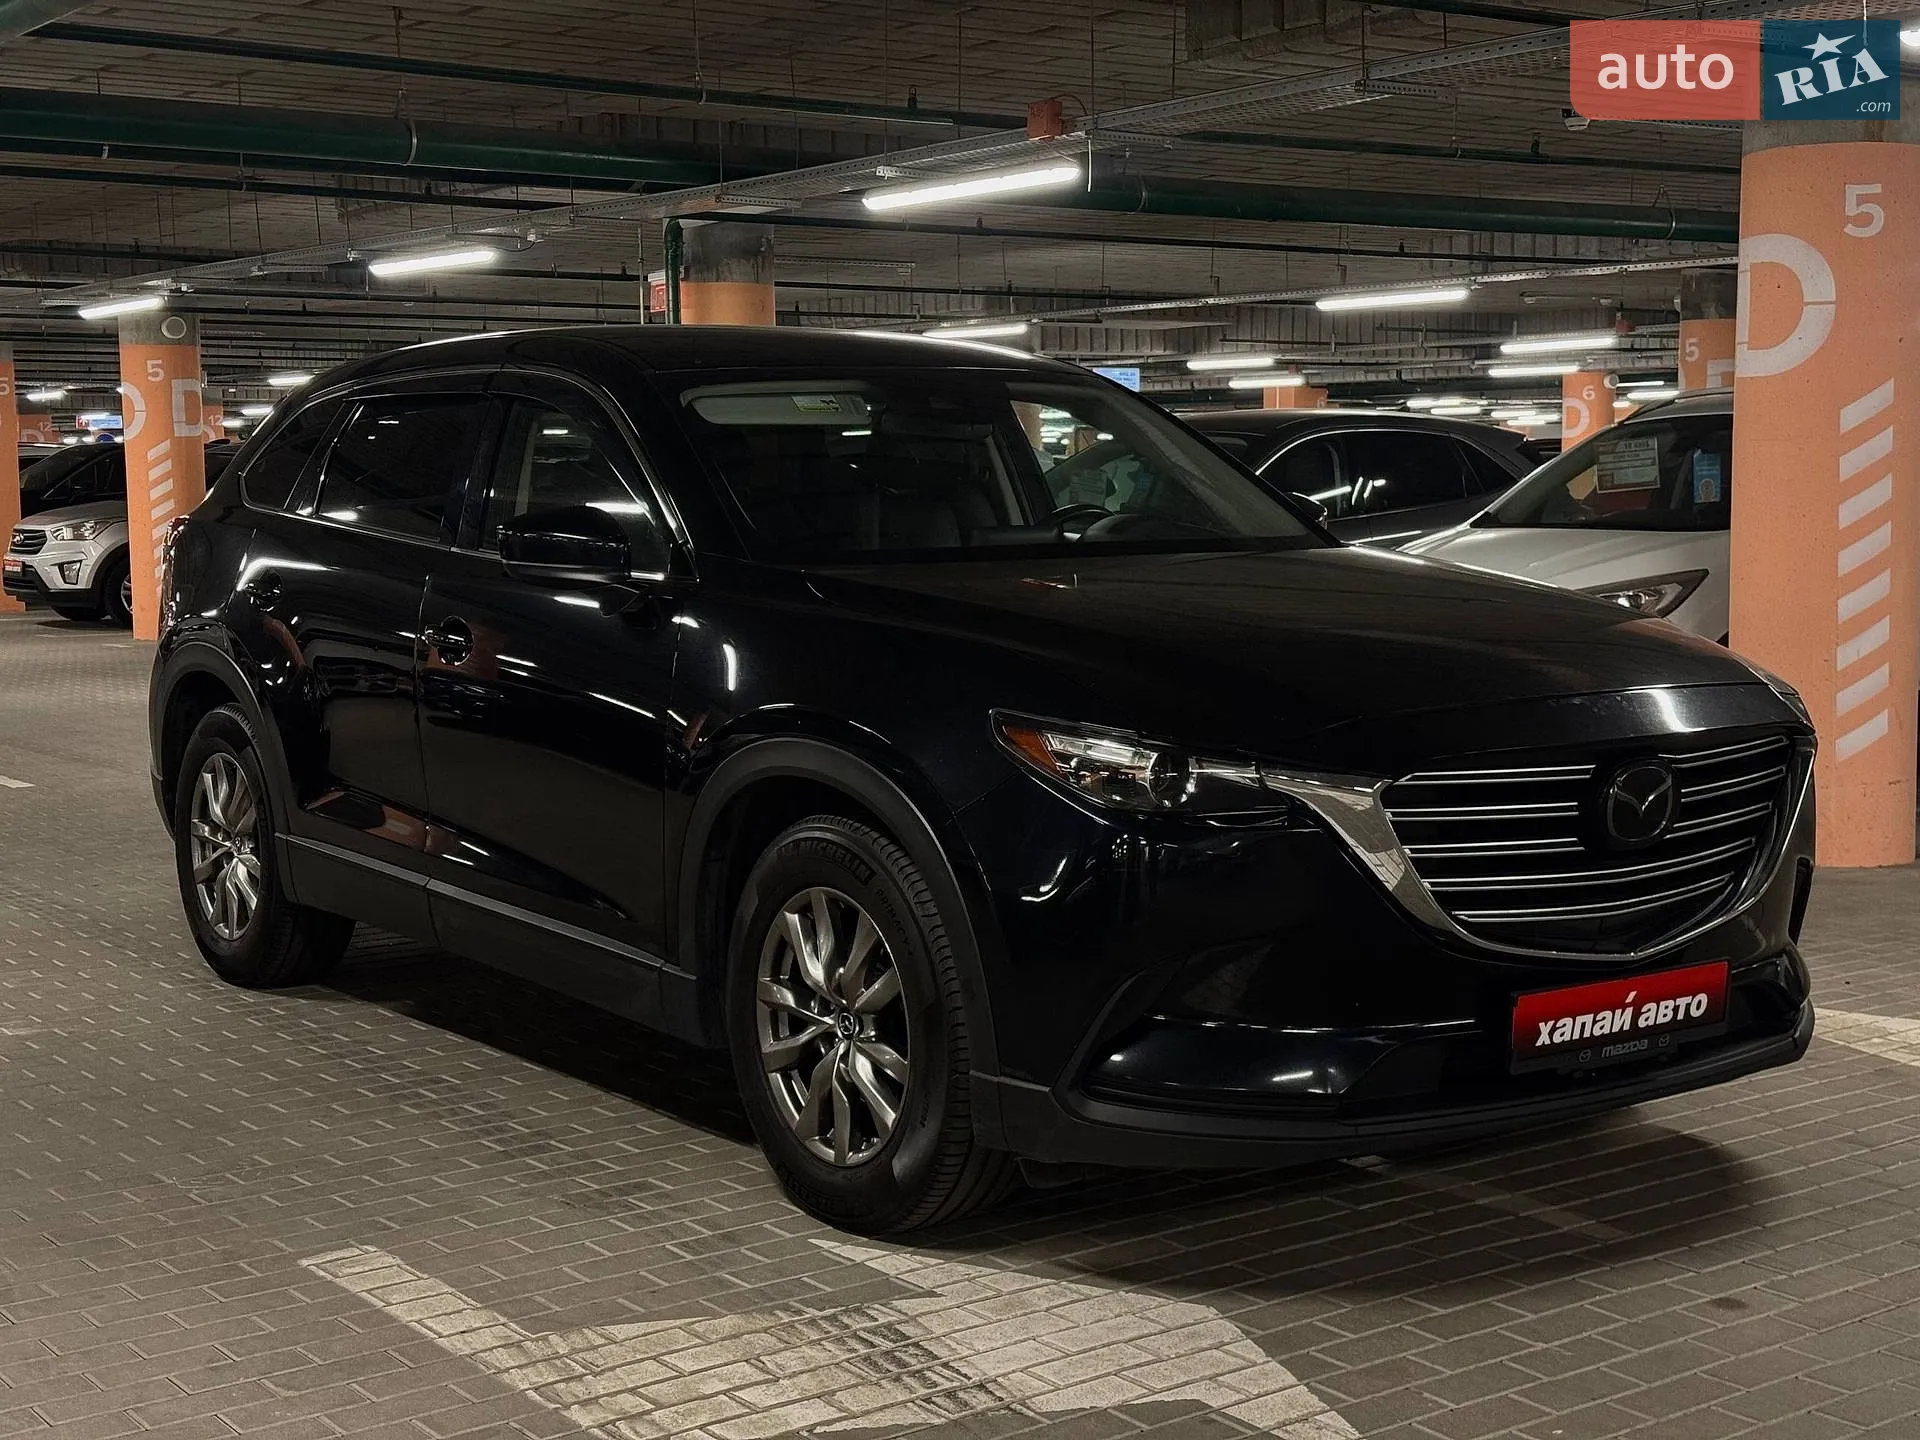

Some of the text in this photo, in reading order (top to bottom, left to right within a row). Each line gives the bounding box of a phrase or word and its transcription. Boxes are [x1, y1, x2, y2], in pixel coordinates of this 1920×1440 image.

[1843, 183, 1885, 238] 5
[1735, 233, 1837, 377] D
[1685, 338, 1700, 362] 5
[146, 359, 165, 382] 5
[171, 378, 202, 437] D
[1582, 385, 1596, 401] 6
[208, 415, 224, 426] 12
[1562, 398, 1590, 438] D
[1637, 992, 1709, 1028] авто
[1600, 1039, 1649, 1059] mazda
